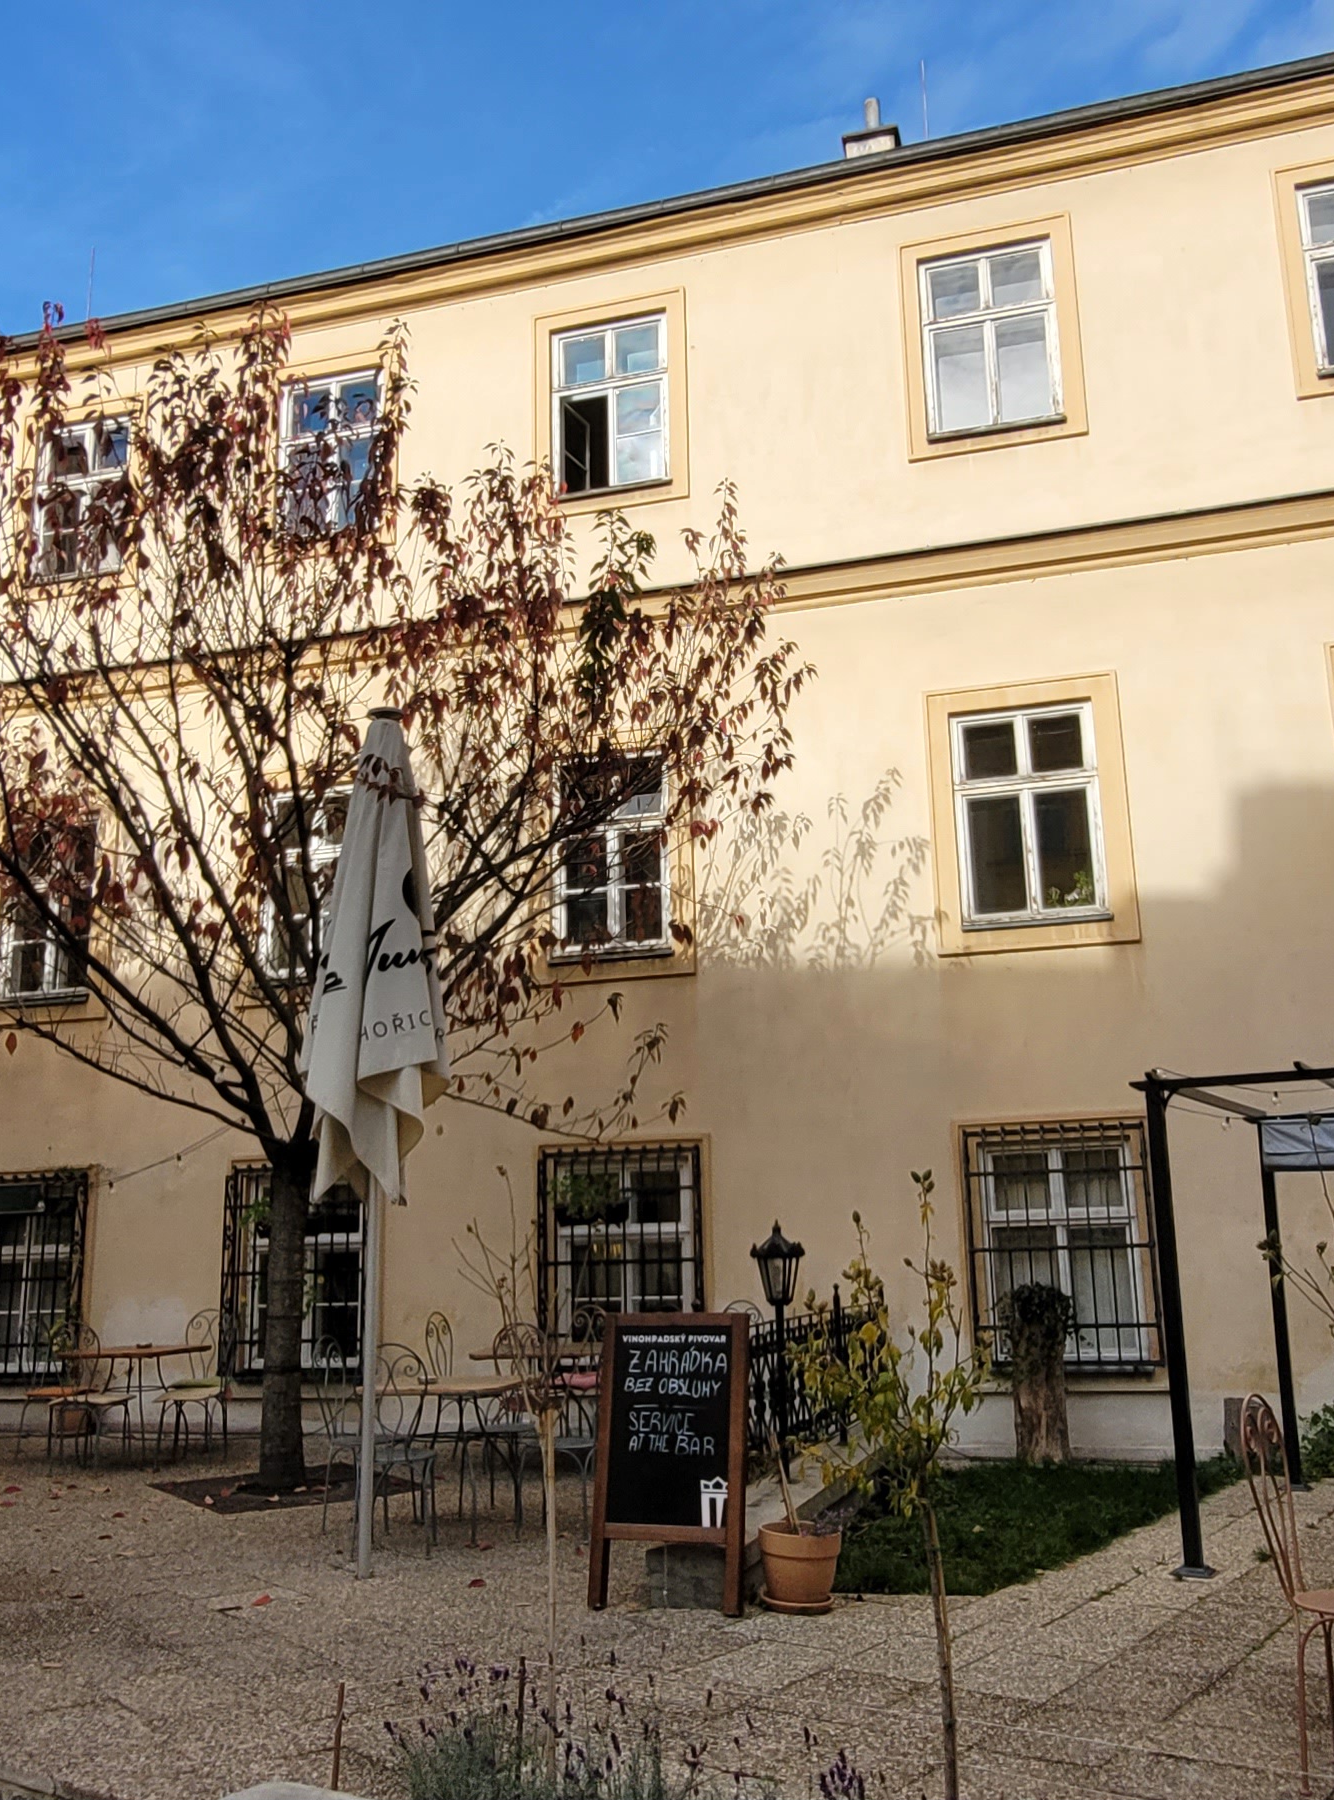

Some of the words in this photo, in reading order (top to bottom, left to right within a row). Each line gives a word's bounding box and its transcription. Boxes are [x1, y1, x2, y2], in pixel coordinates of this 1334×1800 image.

[688, 1335, 727, 1343] PIVOVAR
[628, 1346, 727, 1376] ZAHRÁDKA
[624, 1377, 654, 1393] BEZ
[658, 1378, 722, 1398] OBSLUHY
[629, 1411, 695, 1435] SERVICE
[629, 1433, 645, 1452] AT
[648, 1433, 669, 1453] THE
[674, 1435, 715, 1455] BAR
